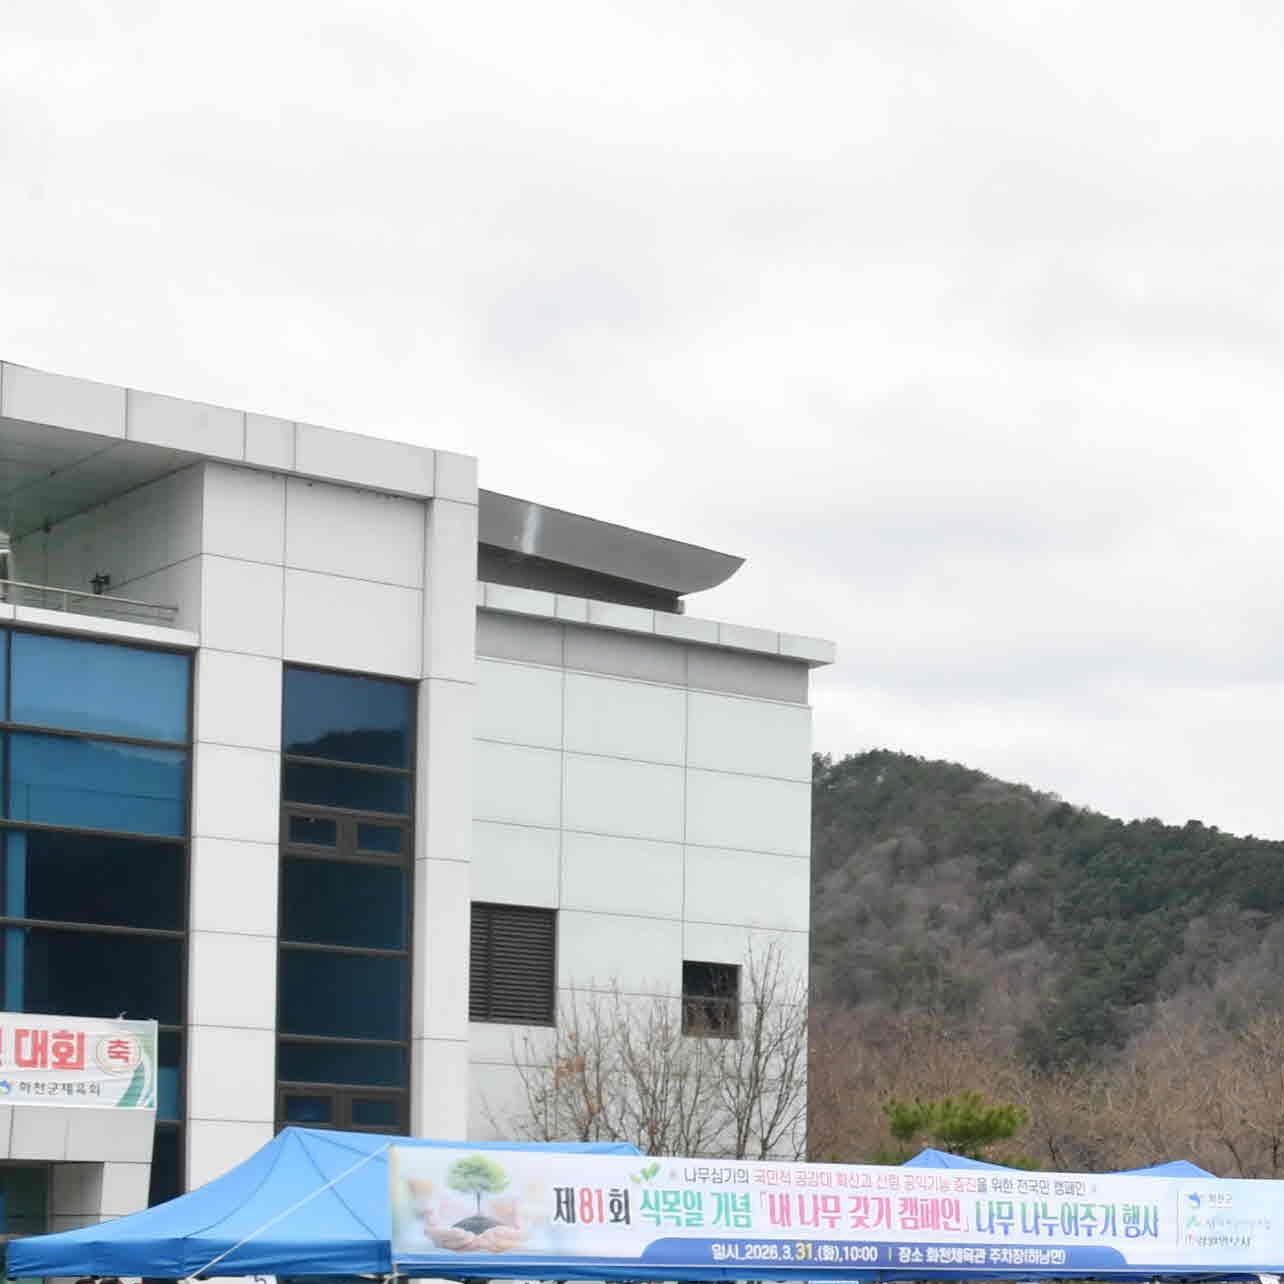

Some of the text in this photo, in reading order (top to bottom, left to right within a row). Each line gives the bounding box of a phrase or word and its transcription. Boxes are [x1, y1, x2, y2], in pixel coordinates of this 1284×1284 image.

[15, 1028, 85, 1070] 대회
[107, 1039, 131, 1062] 축
[683, 1167, 749, 1185] 나무심기의
[991, 1176, 1014, 1194] 위한
[1016, 1178, 1050, 1196] 전국민
[553, 1187, 631, 1225] 제81회
[639, 1189, 705, 1228] 식목일
[711, 1191, 752, 1229] 기념
[799, 1193, 842, 1230] 나무
[848, 1195, 891, 1231] 갖기
[975, 1199, 1015, 1236] 나무
[1020, 1201, 1118, 1238] 나누어주기
[1122, 1203, 1160, 1239] 행사
[898, 1246, 923, 1264] 장소
[926, 1246, 985, 1265] 화천체육관
